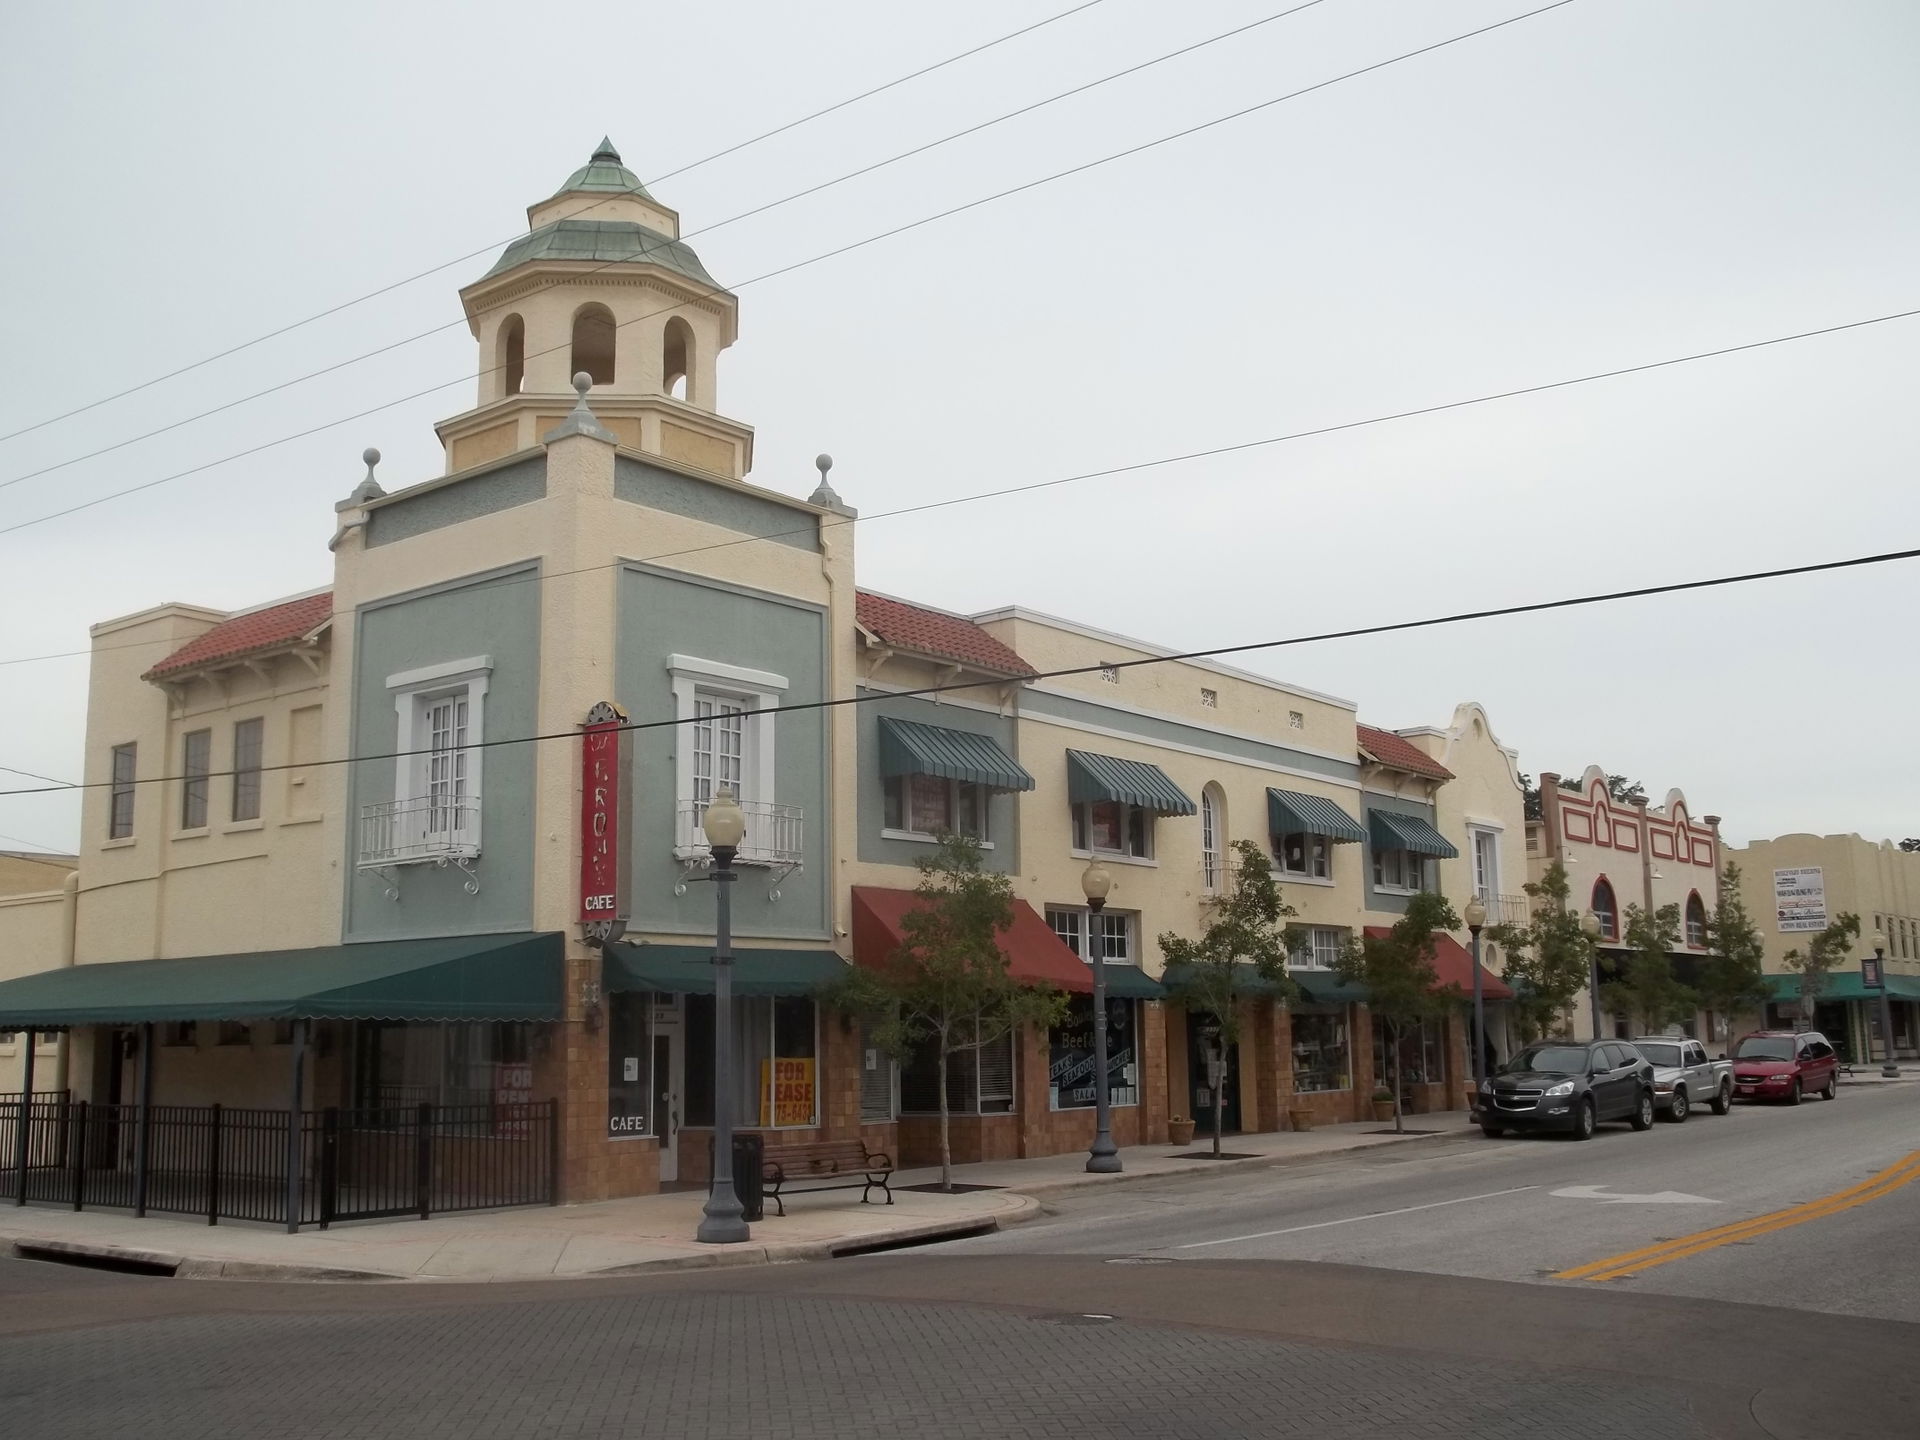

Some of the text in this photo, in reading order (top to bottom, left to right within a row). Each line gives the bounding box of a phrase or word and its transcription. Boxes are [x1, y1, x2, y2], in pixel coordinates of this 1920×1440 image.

[585, 894, 615, 911] CAFE
[1062, 1031, 1087, 1048] Beef
[775, 1062, 805, 1081] FOR
[1053, 1055, 1072, 1076] EAKS
[1063, 1057, 1095, 1085] SEAFOOD
[503, 1070, 532, 1088] FOR
[498, 1090, 530, 1104] REN
[766, 1083, 812, 1102] LEASE
[1075, 1089, 1096, 1100] SALA
[610, 1116, 643, 1131] CAFE
